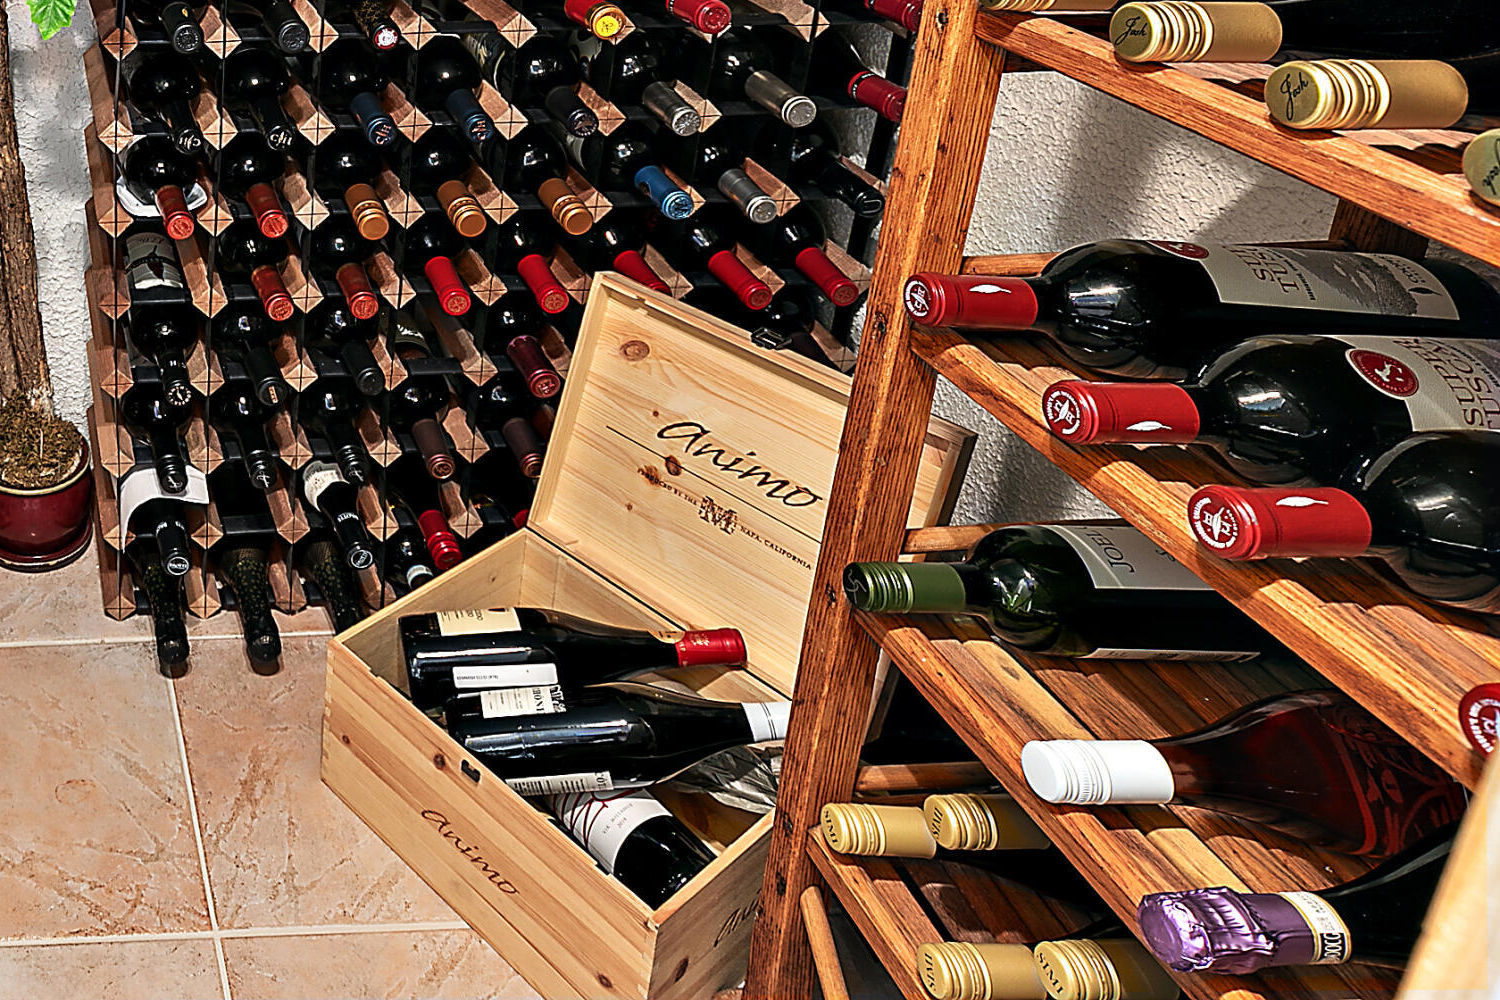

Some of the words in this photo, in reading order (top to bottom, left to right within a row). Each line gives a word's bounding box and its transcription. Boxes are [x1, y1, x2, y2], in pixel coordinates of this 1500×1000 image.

[1114, 17, 1148, 46] Josh
[1281, 72, 1309, 121] Josh
[764, 539, 812, 571] CALIFORNIA
[1086, 531, 1135, 574] JOEL
[823, 810, 839, 844] SIMI
[931, 807, 944, 840] SIMI
[924, 952, 937, 993] SIMI
[1036, 952, 1065, 995] SIMI
